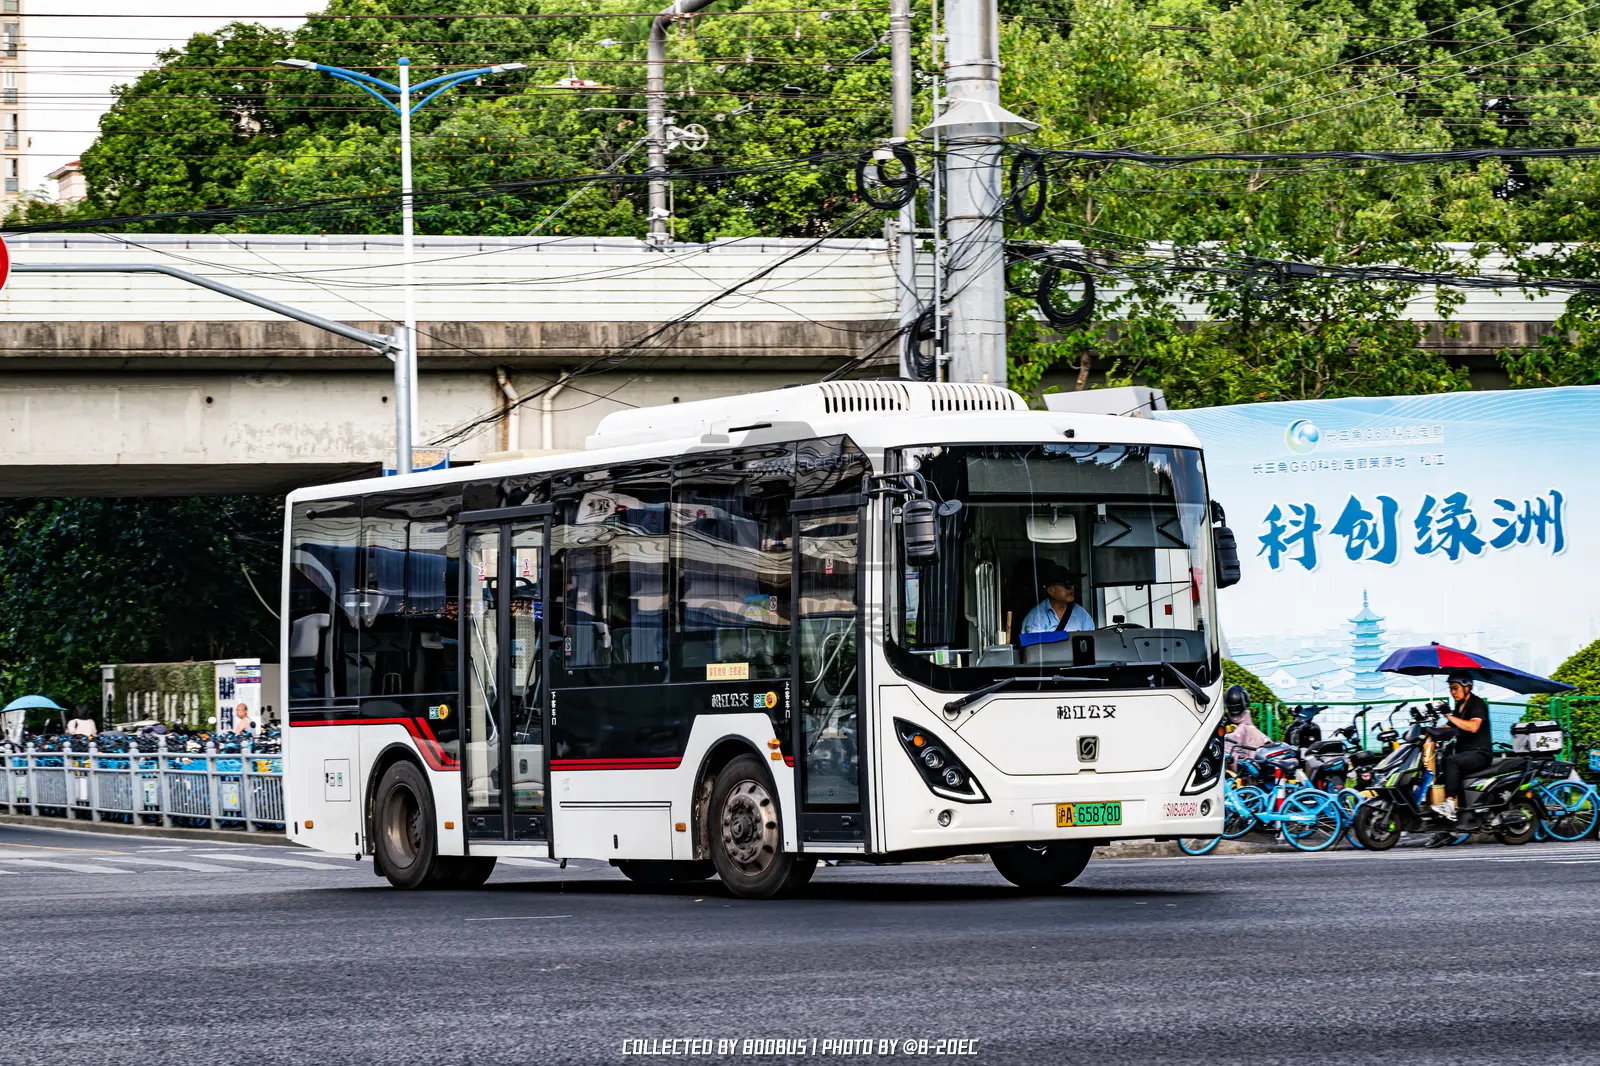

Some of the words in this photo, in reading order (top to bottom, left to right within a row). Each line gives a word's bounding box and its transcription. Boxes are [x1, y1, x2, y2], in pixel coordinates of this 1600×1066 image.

[1256, 489, 1565, 571] 科创绿洲
[711, 693, 749, 708] 松江公交
[1056, 704, 1117, 720] 松江公交
